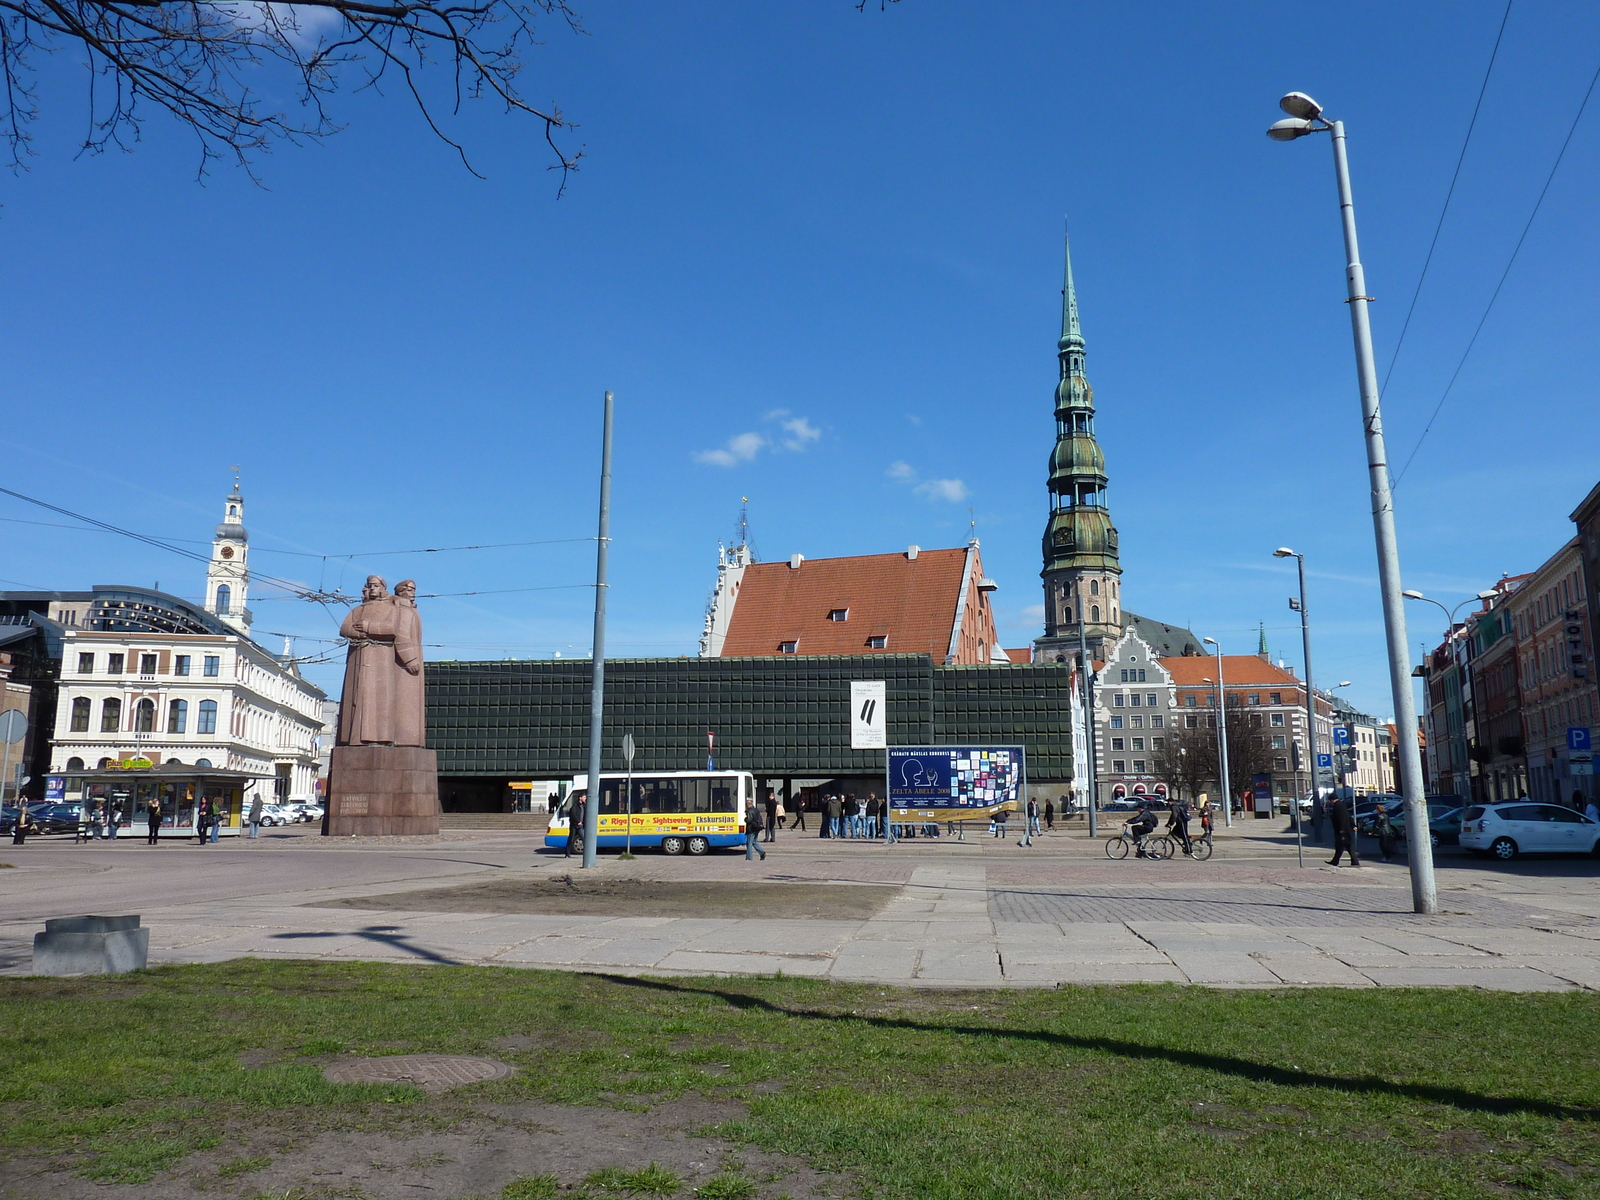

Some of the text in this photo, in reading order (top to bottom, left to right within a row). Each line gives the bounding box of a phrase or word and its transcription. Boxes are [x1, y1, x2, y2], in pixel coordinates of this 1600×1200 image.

[1566, 611, 1584, 679] HOTEL
[1572, 730, 1585, 747] P
[1320, 755, 1328, 766] P
[653, 817, 691, 825] Sightseeing
